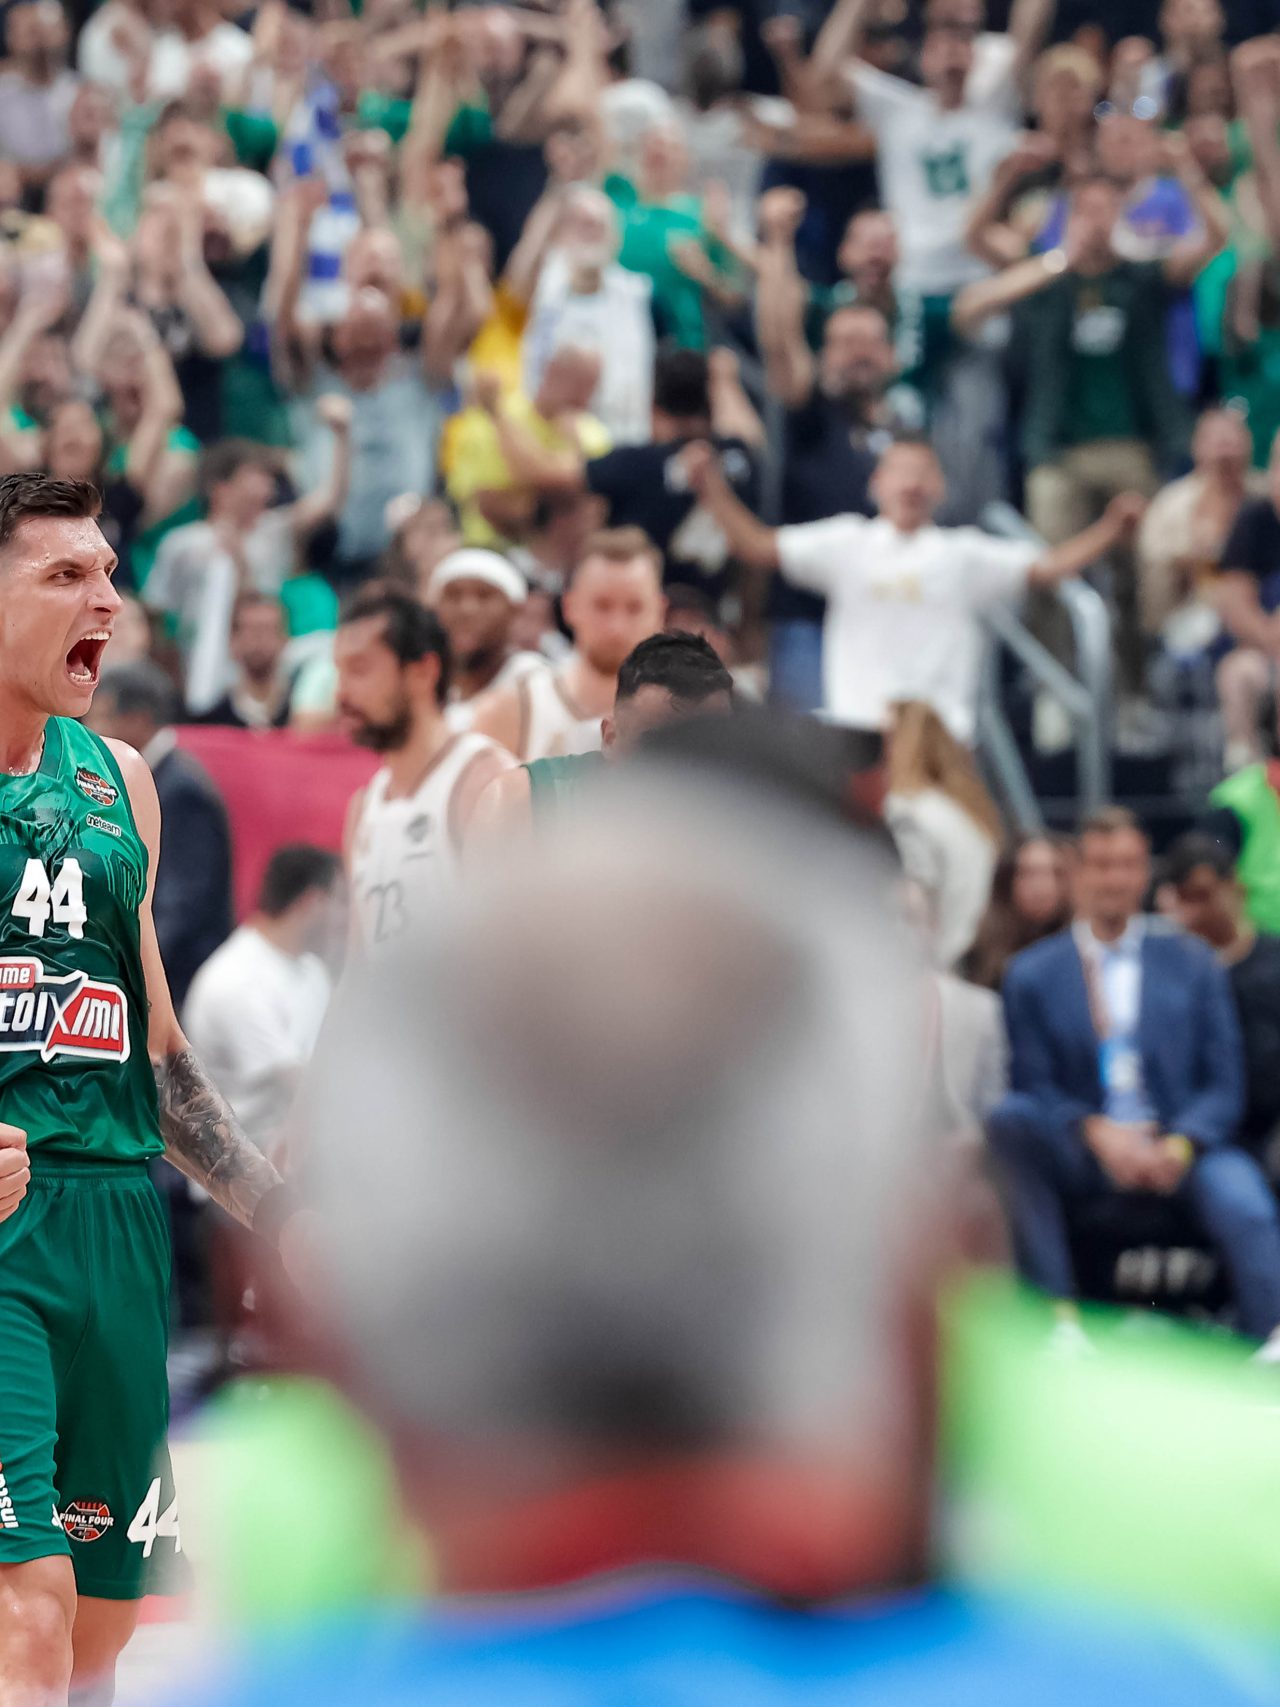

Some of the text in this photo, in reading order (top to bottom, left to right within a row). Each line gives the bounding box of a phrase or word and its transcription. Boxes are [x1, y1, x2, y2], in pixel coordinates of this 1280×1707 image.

[11, 858, 87, 939] 44
[59, 1512, 88, 1524] FINAL
[88, 1515, 114, 1526] FOUR
[126, 1475, 181, 1559] 44
